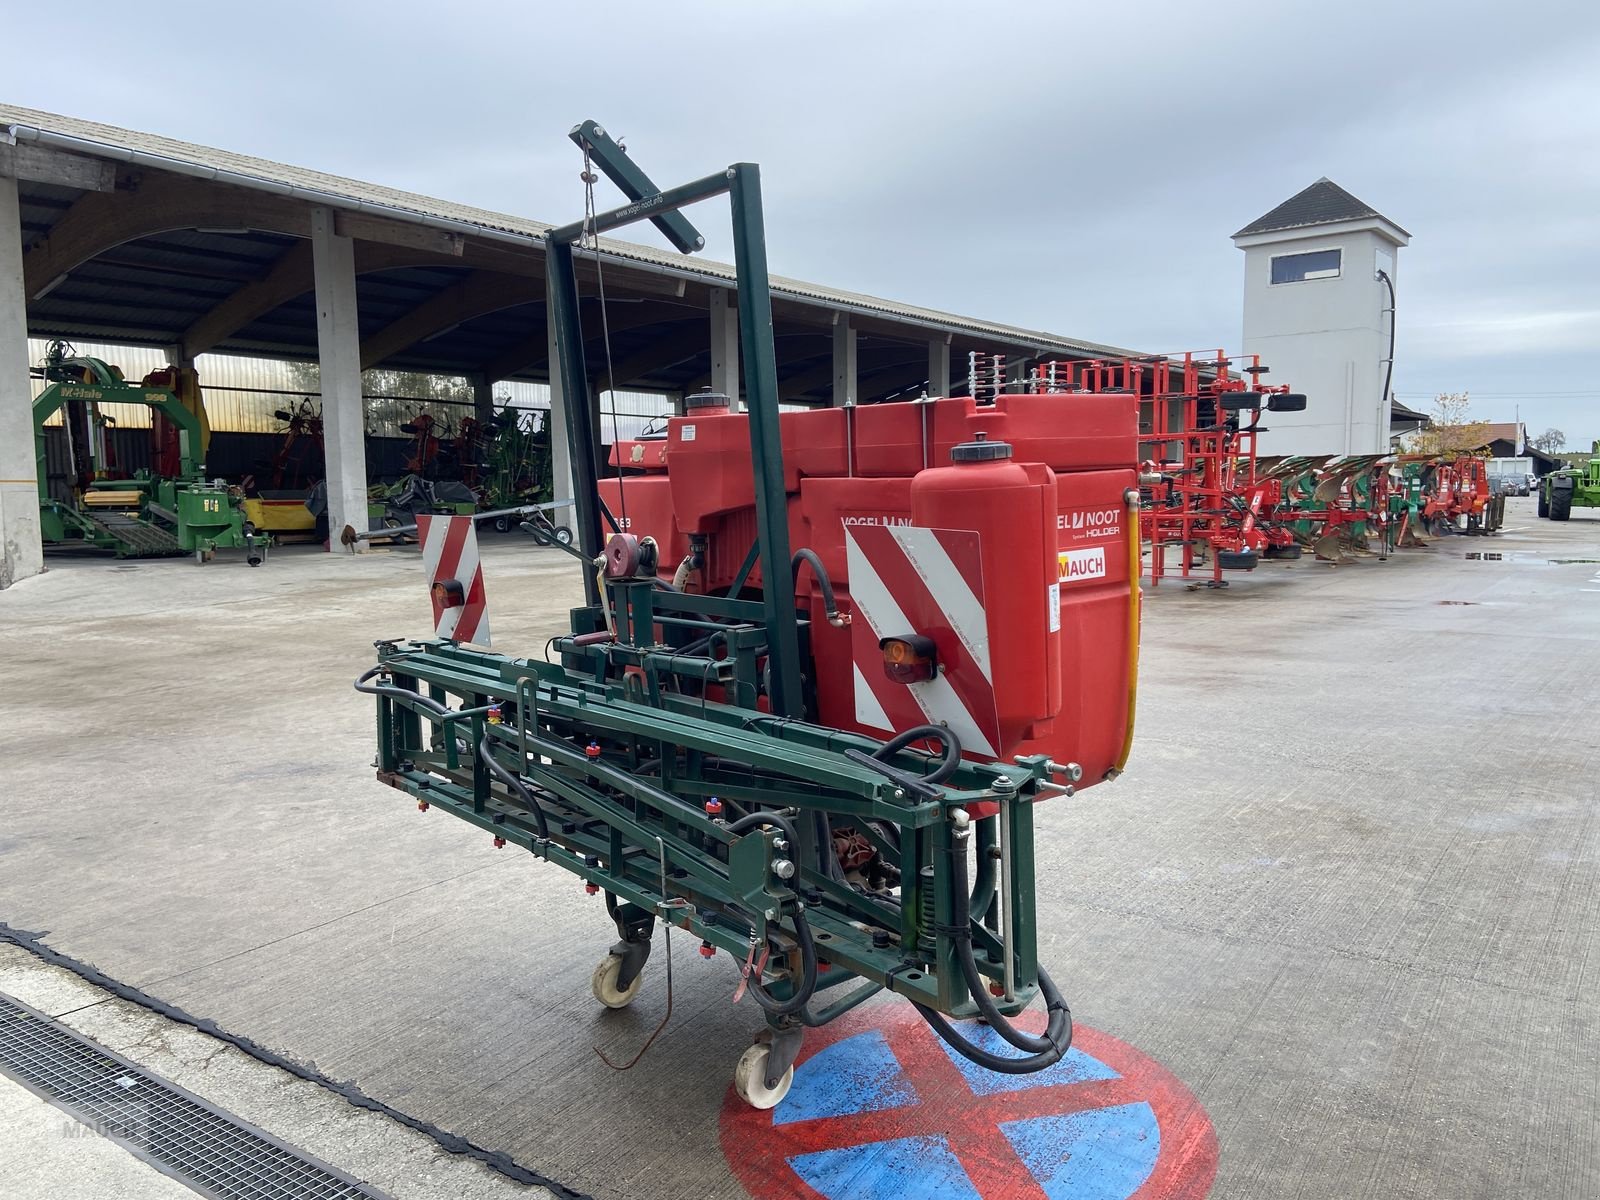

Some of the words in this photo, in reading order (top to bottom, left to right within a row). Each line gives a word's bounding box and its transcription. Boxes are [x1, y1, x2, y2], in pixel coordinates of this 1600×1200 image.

[1086, 509, 1120, 526] NOOT
[1086, 526, 1120, 538] HOLDER
[1058, 557, 1103, 578] MAUCH
